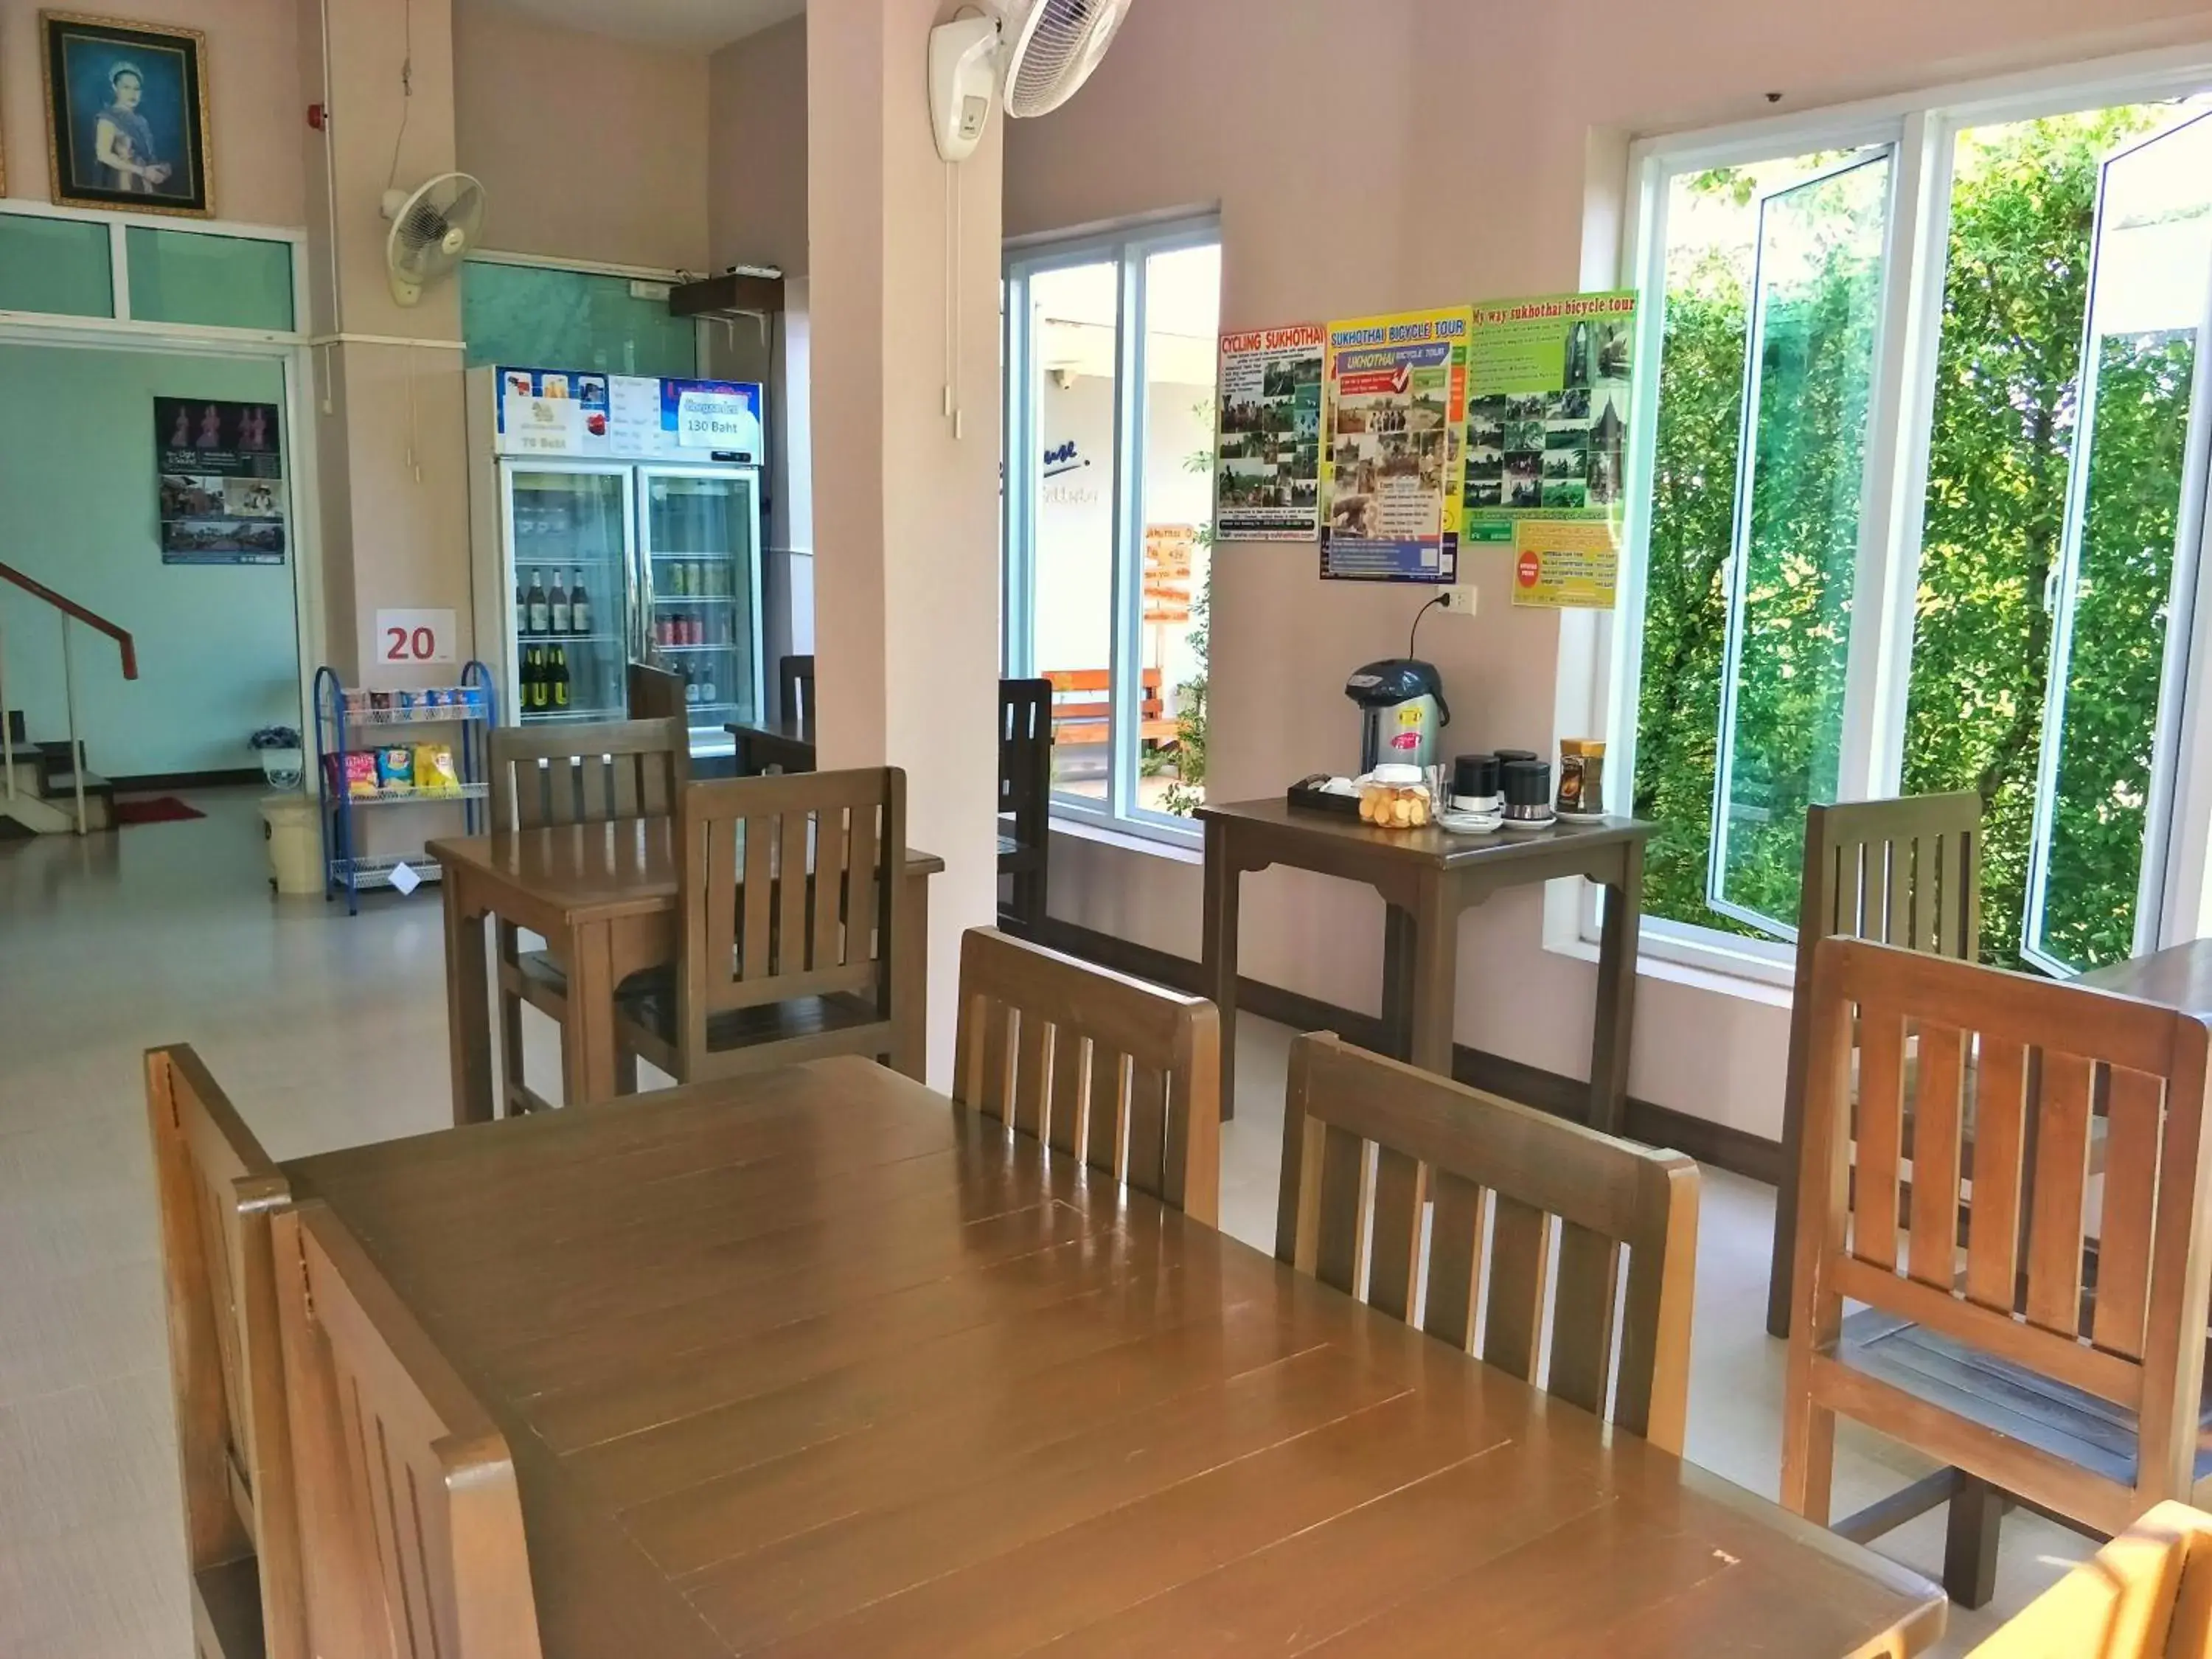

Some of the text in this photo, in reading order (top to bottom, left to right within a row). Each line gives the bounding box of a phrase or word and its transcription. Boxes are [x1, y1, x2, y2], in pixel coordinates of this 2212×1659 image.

[1473, 297, 1635, 326] My way sukhothai bicycle tour
[1222, 327, 1324, 352] CYCLING SUKHOTHAI
[1331, 319, 1466, 347] SUKHOTHAI BICYCLE TOUR
[688, 420, 737, 434] 130 Baht
[387, 627, 434, 660] 20
